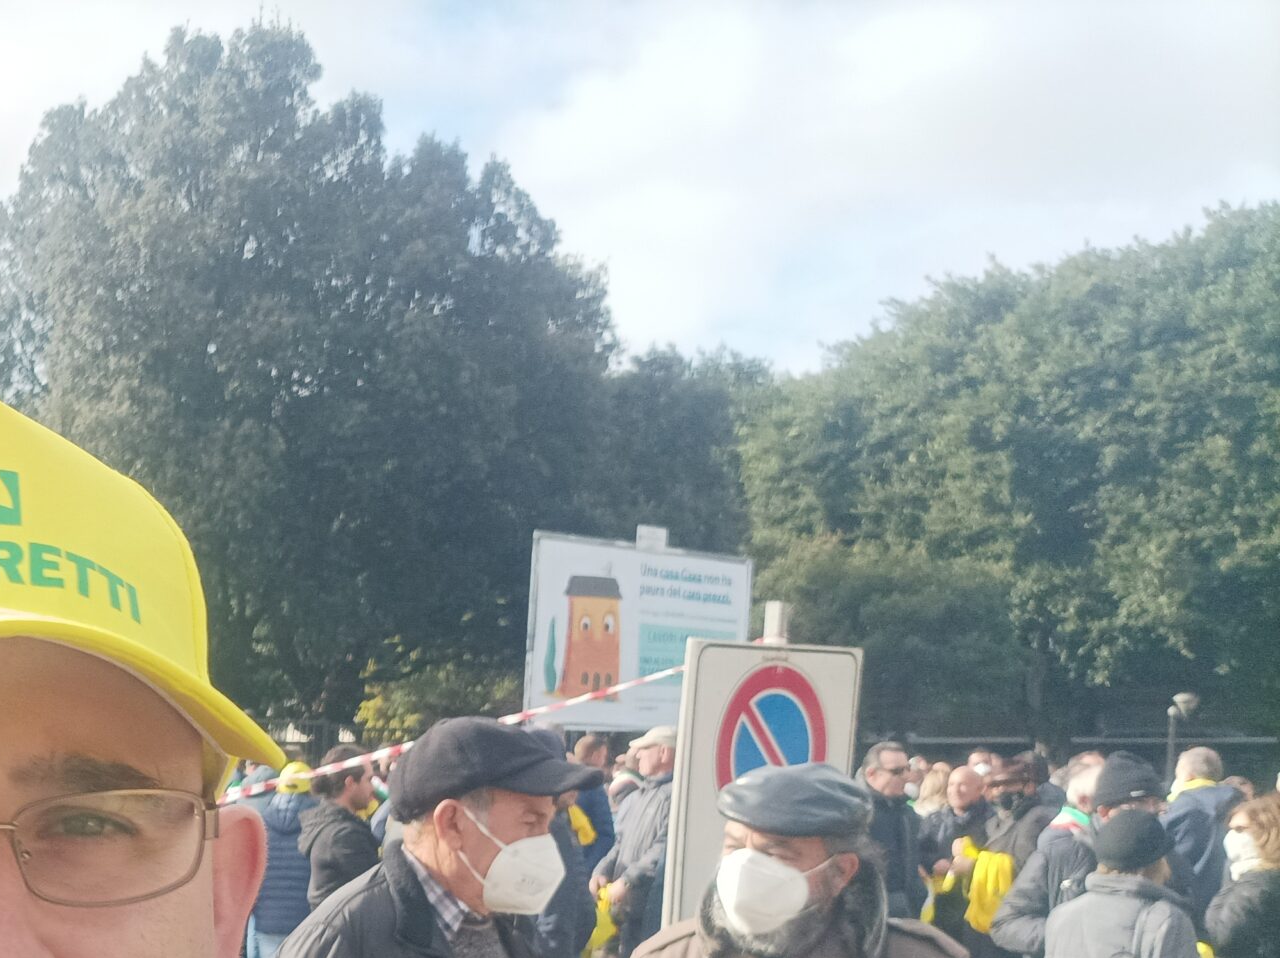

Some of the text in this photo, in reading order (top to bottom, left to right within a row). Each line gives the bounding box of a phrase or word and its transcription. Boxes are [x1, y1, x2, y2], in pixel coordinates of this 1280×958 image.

[640, 563, 658, 577] Una
[660, 569, 679, 581] casa
[703, 575, 720, 586] non
[721, 574, 732, 587] ha
[666, 584, 681, 598] del
